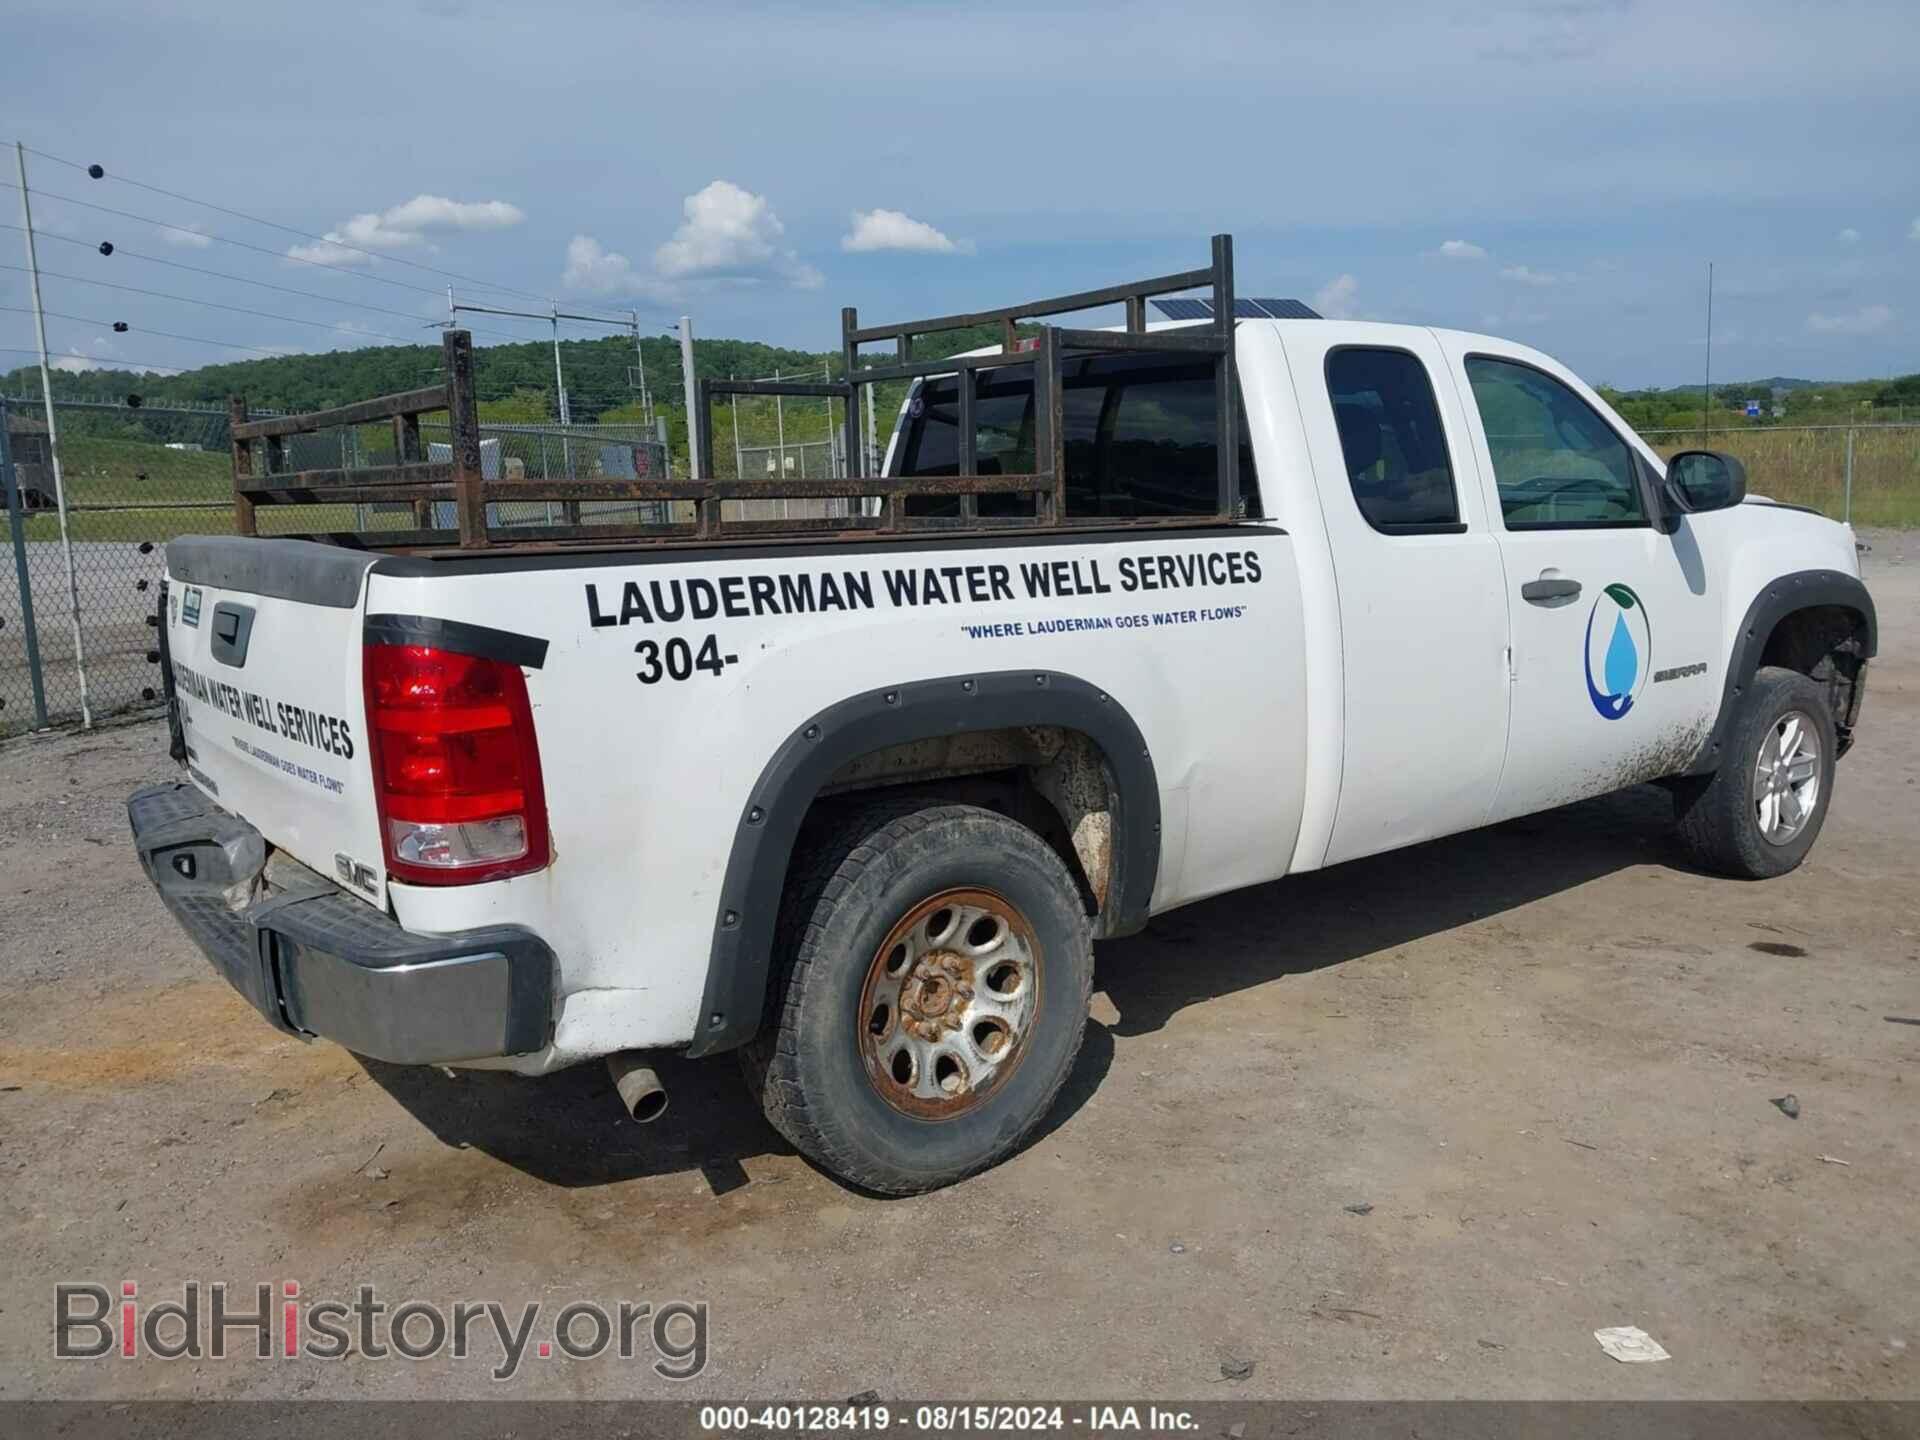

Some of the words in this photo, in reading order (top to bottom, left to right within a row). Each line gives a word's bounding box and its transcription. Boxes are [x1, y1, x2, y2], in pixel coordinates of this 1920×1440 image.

[585, 570, 875, 628] LAUDERMAN
[882, 564, 1016, 608] WATER
[1020, 560, 1112, 599] WELL
[1118, 550, 1263, 592] SERVICES
[1027, 617, 1113, 635] LAUDERMAN
[1115, 614, 1150, 629] GOES
[1152, 610, 1198, 626] WATER
[634, 634, 739, 685] 304-
[1654, 662, 1707, 683] SIERRA
[207, 678, 245, 721] WATER
[242, 690, 278, 733] WELL
[277, 701, 354, 760] SERVICES
[335, 853, 379, 898] GMC
